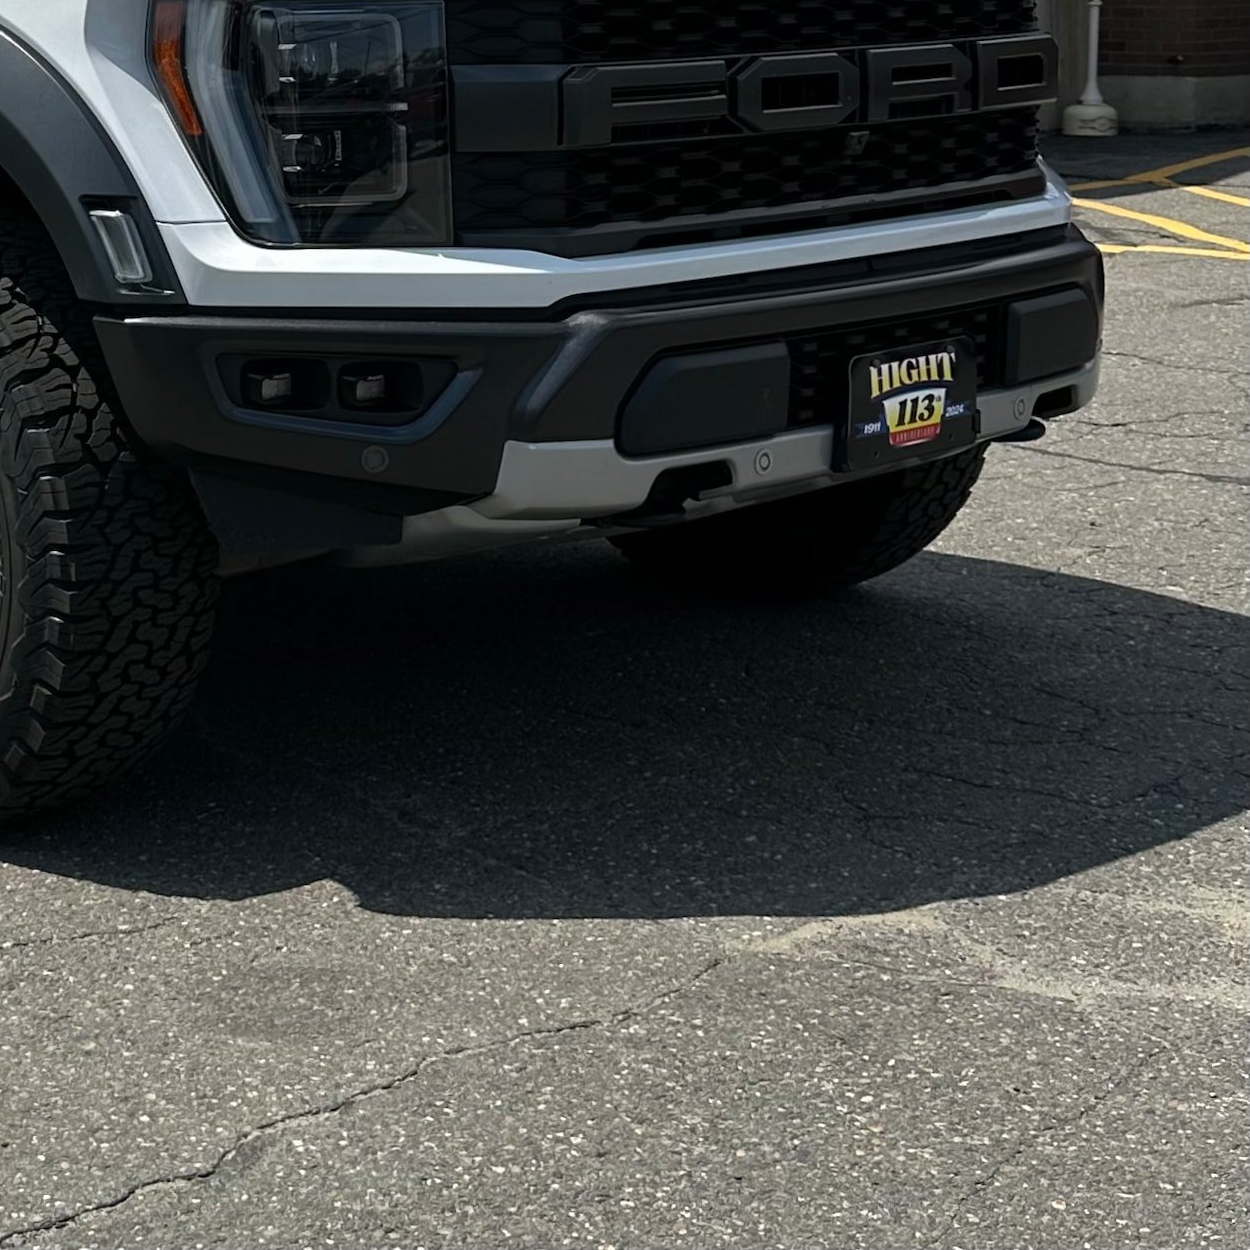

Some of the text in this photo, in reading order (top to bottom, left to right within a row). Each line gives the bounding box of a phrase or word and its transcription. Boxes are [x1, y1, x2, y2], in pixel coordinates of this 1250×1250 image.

[563, 33, 1059, 148] FORD
[868, 351, 956, 400] HIGHT
[863, 421, 882, 435] 1911
